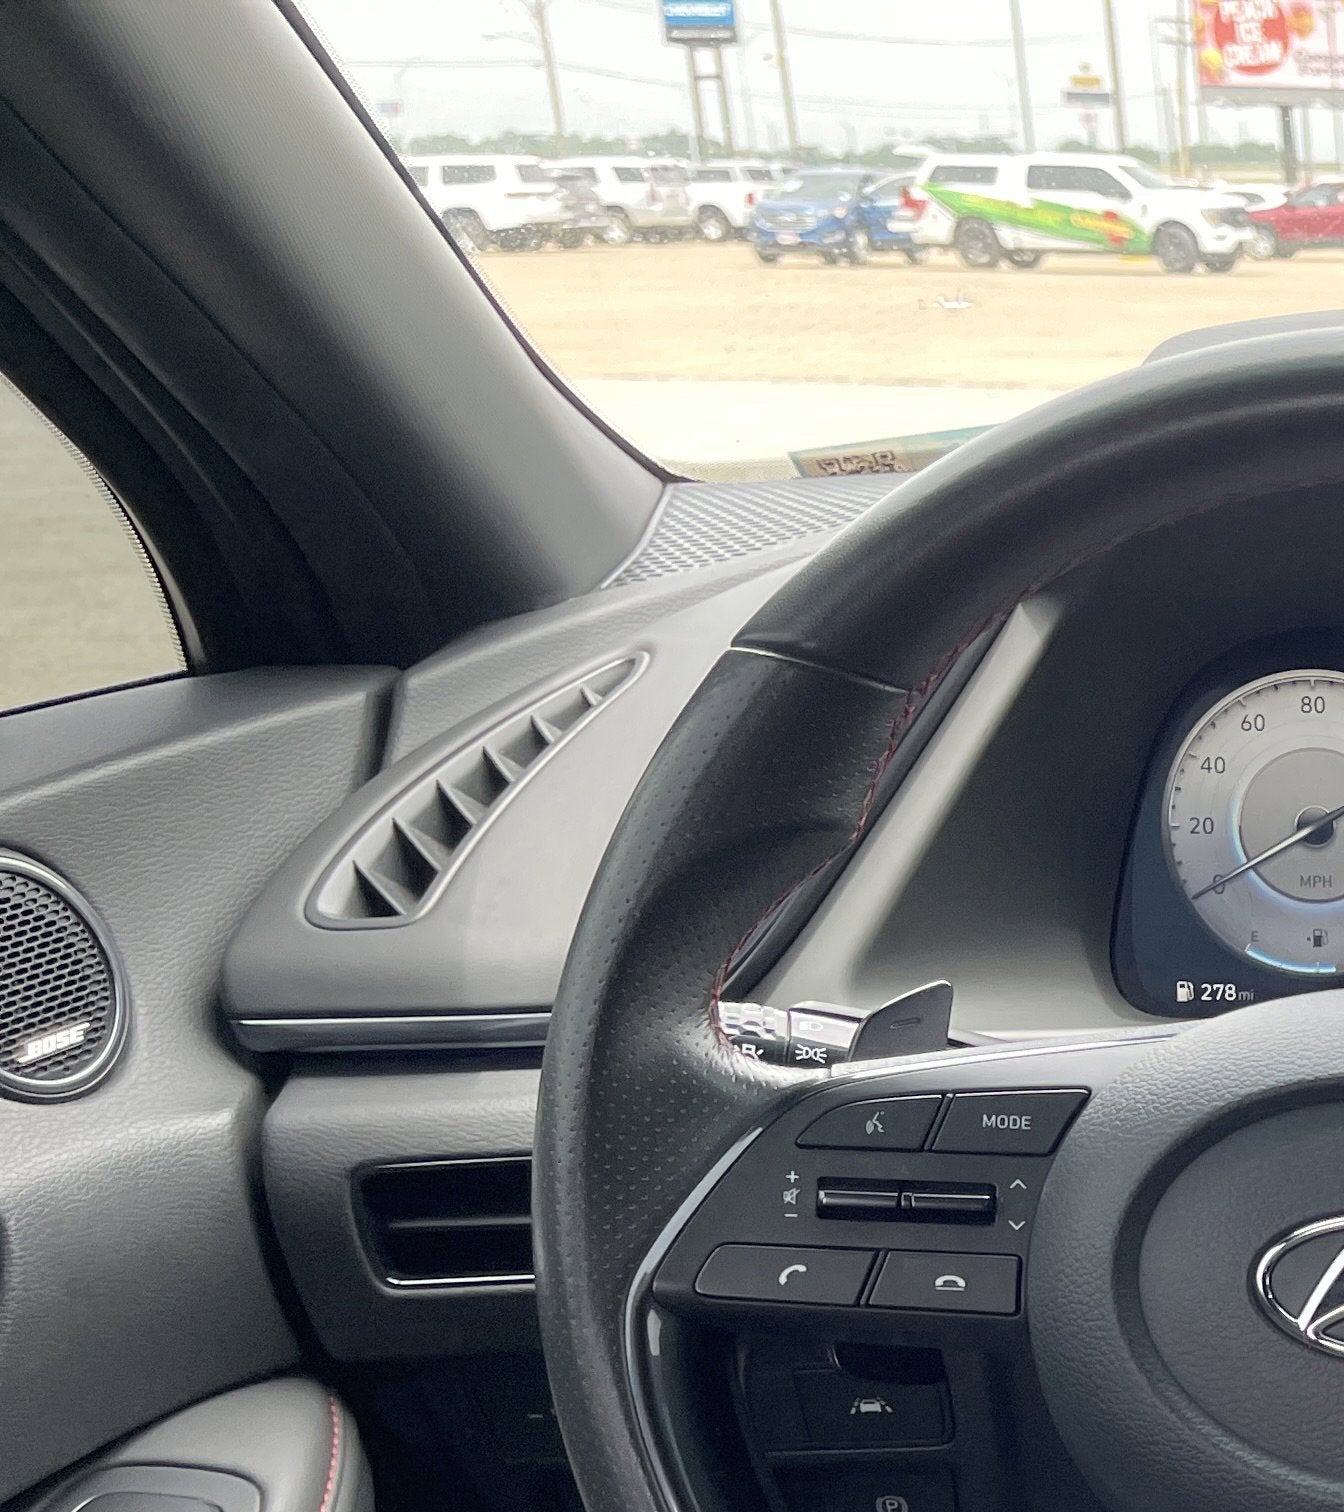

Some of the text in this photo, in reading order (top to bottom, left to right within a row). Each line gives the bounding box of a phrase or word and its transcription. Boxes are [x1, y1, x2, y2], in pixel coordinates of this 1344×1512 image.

[1300, 696, 1326, 714] 80
[1240, 714, 1266, 732] 60
[1201, 757, 1226, 774] 40
[1189, 817, 1214, 835] 20
[1299, 875, 1333, 889] MPH
[1251, 930, 1259, 943] E
[1200, 983, 1254, 1001] 278 mi
[17, 1022, 91, 1064] BOSE
[981, 1114, 1032, 1131] MODE
